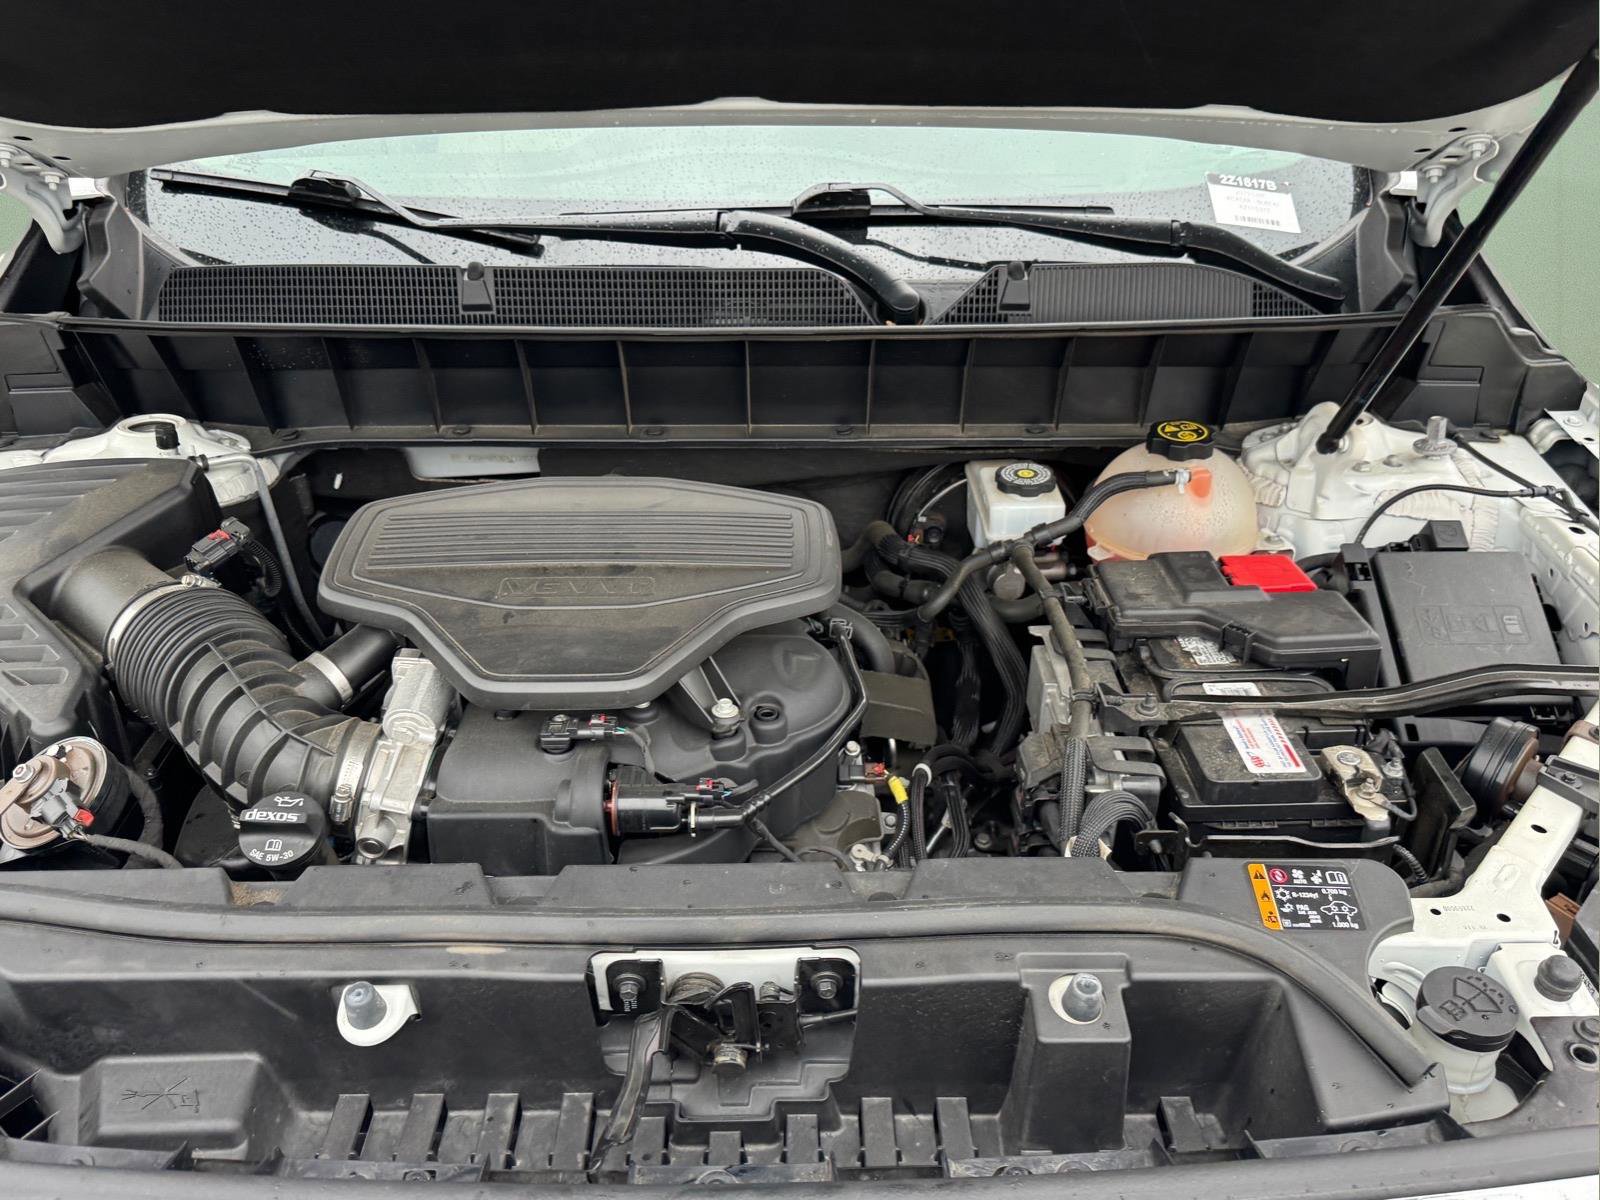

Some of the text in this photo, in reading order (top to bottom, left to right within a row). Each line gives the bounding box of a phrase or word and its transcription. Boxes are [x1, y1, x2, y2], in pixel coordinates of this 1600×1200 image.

[244, 808, 302, 822] dexos
[249, 848, 294, 862] SAE 5W-30
